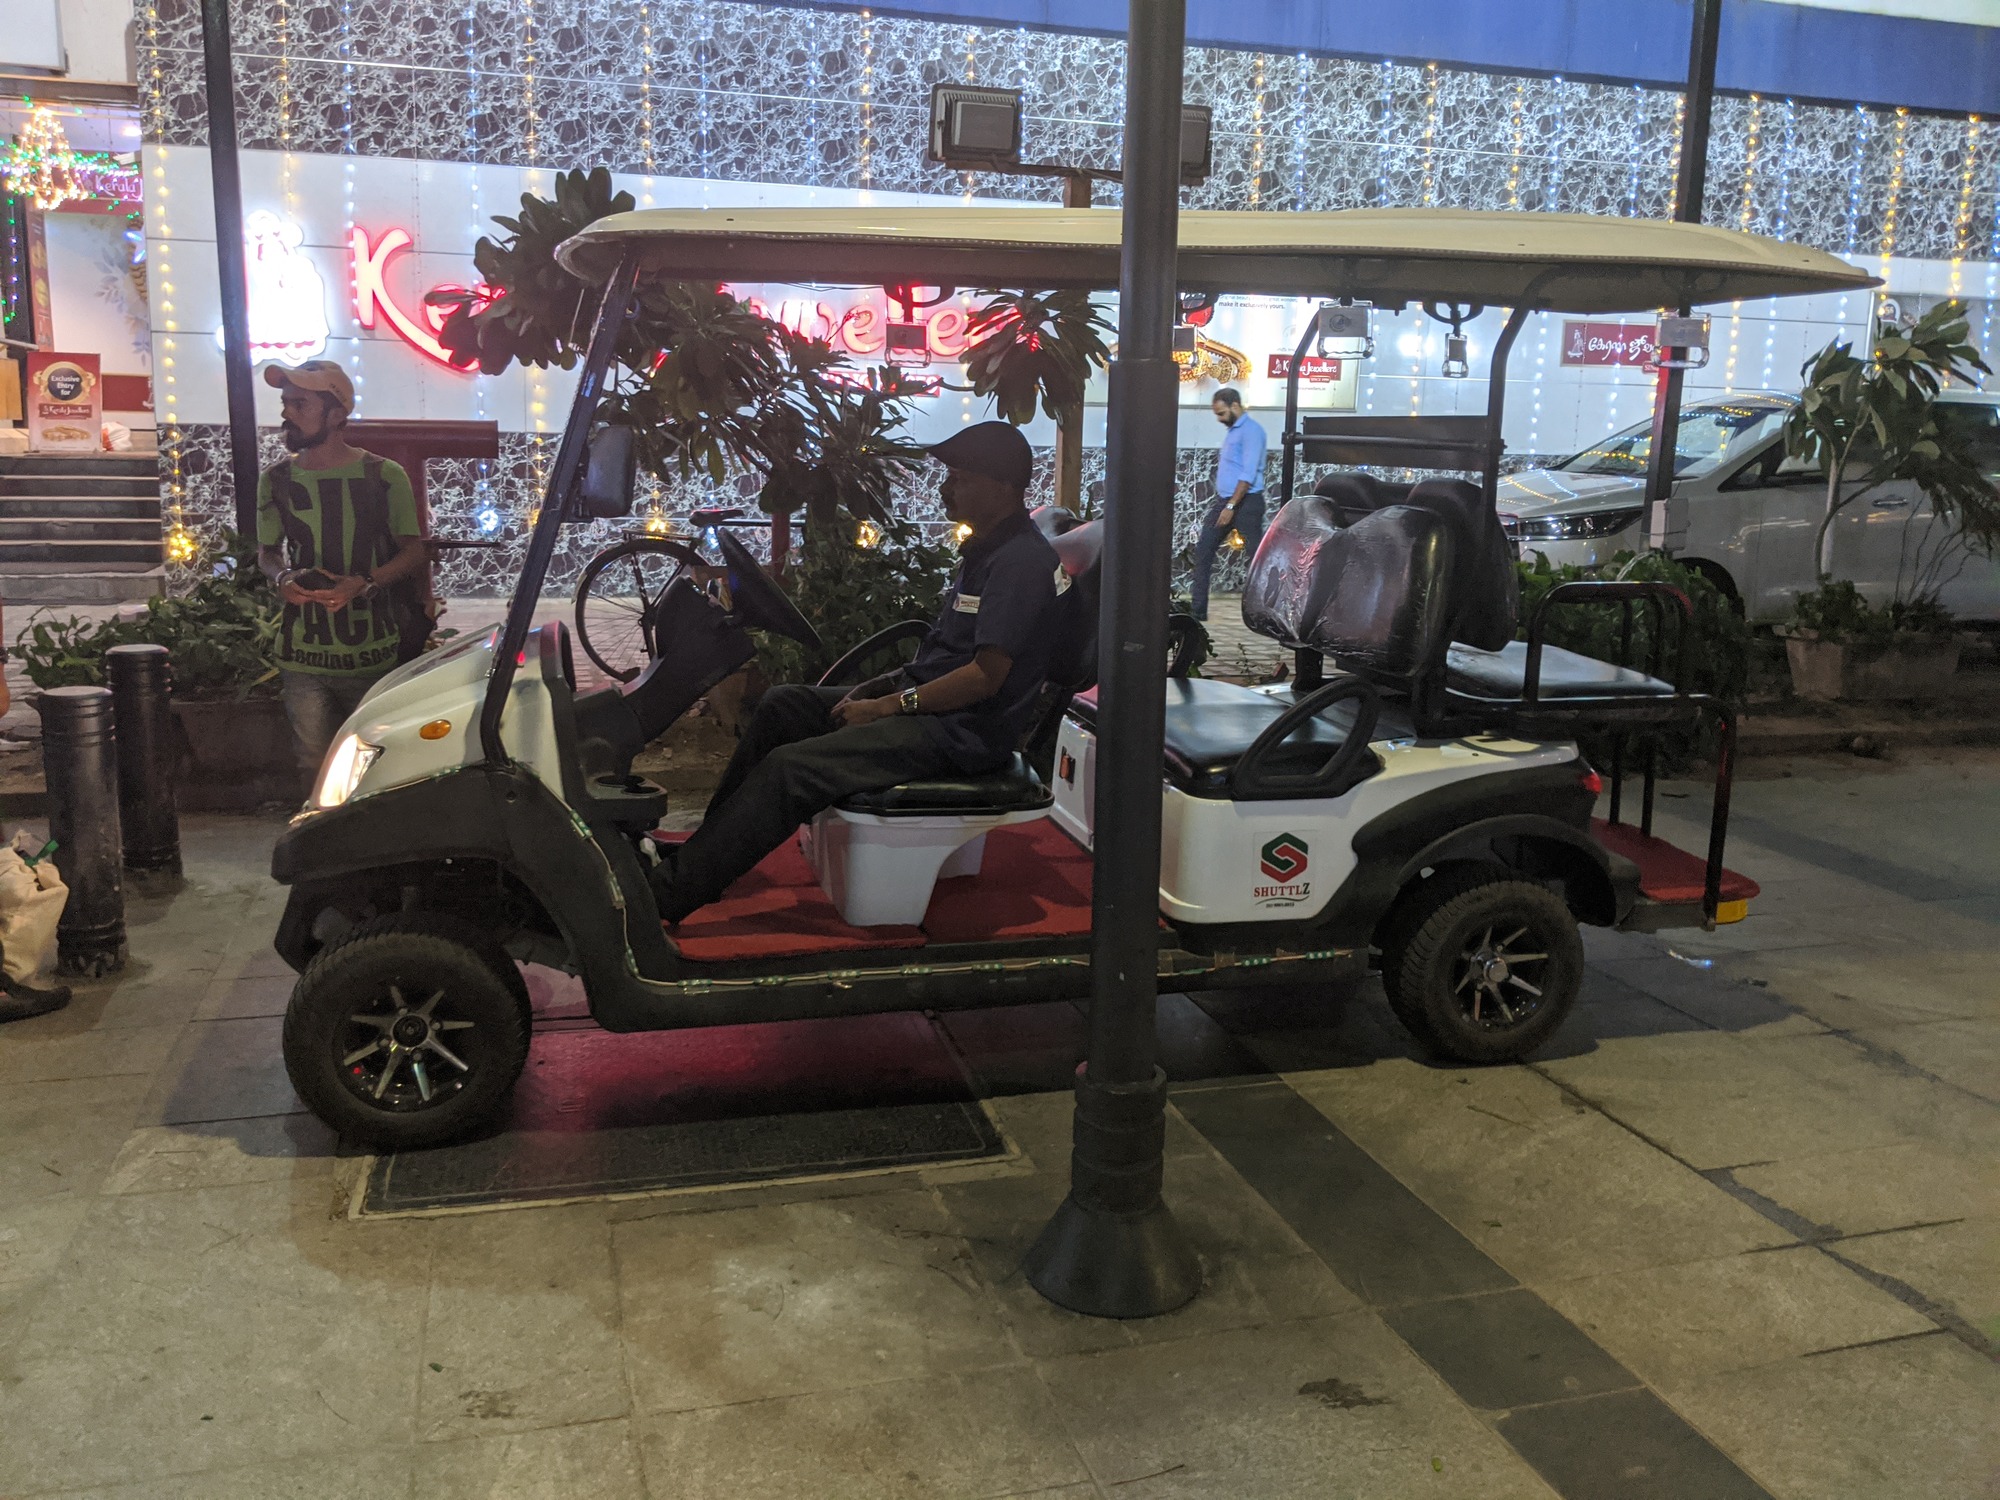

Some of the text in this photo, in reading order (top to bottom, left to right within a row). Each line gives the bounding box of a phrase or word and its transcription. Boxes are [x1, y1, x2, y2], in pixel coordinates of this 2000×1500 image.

[51, 375, 80, 383] Exclusive
[57, 382, 75, 390] Entry
[1254, 882, 1310, 897] SHUTTLZ
